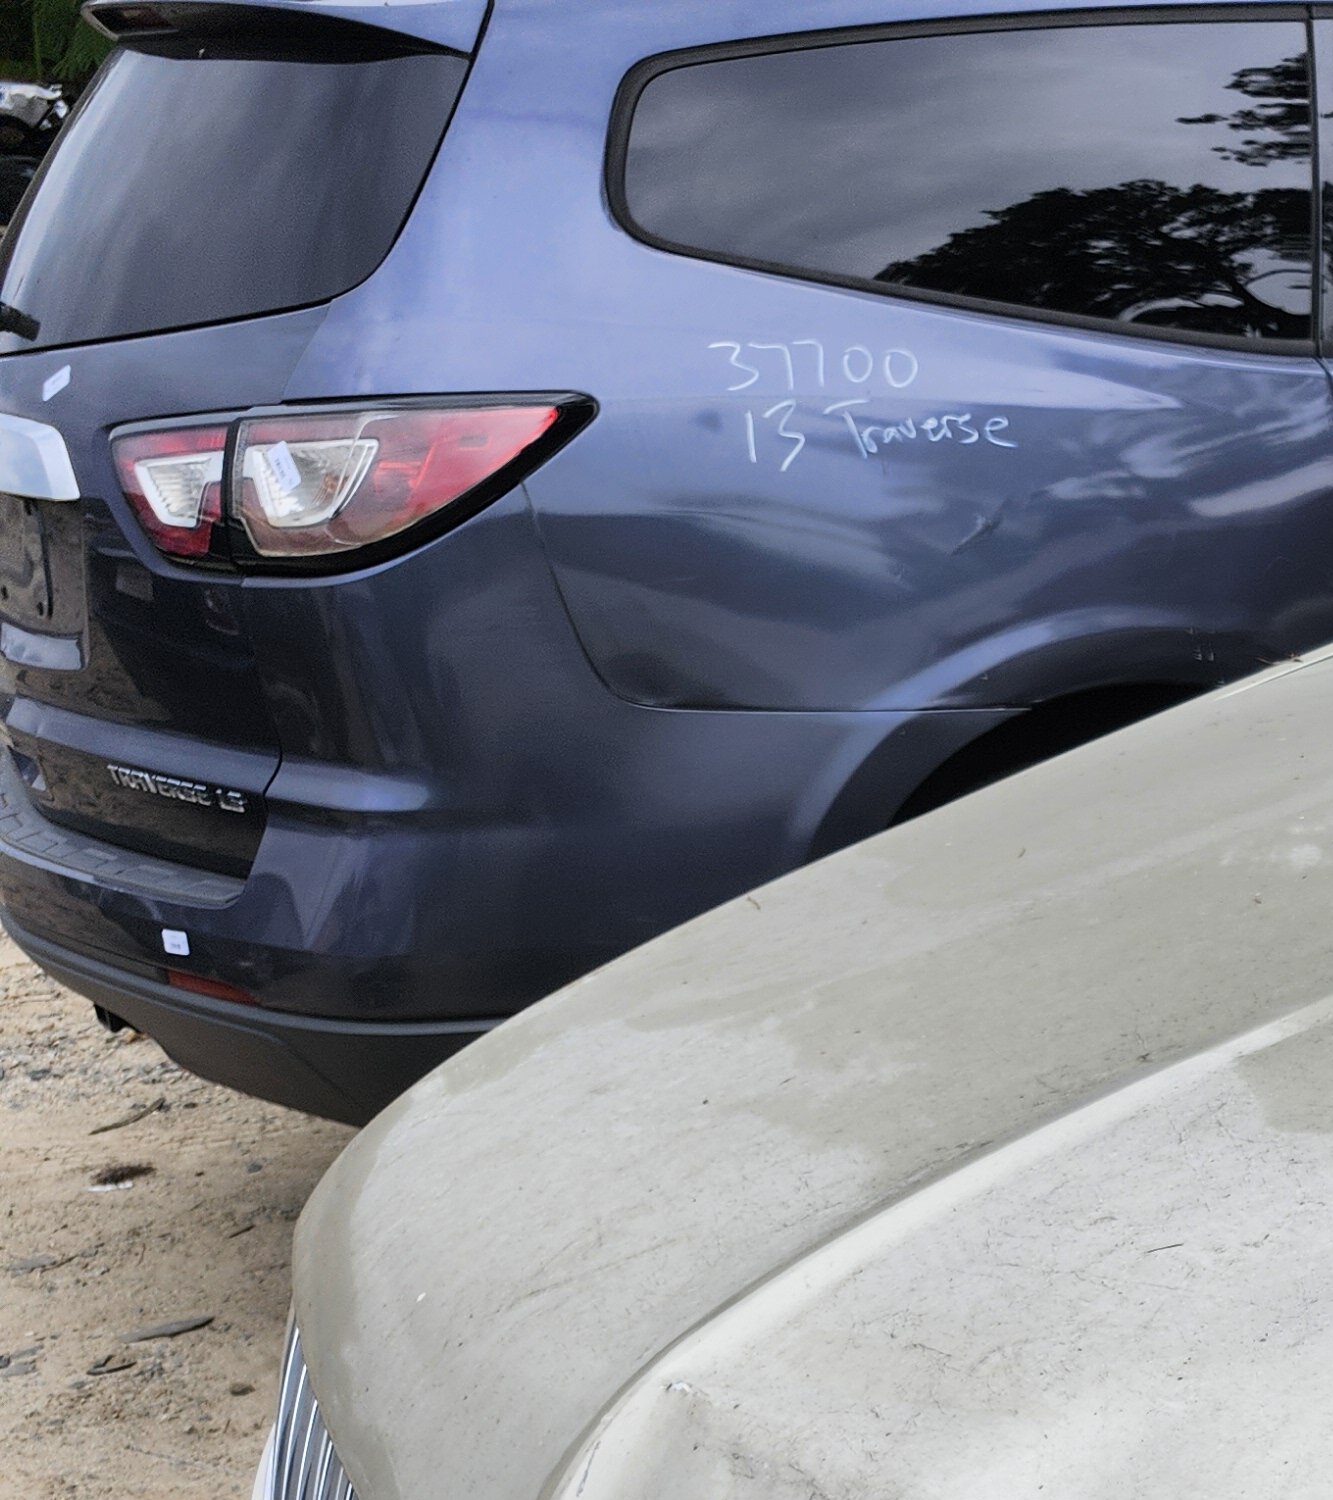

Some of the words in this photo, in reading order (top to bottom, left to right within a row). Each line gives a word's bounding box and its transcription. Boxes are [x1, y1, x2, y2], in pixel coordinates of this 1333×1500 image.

[707, 340, 919, 391] 37700
[744, 399, 806, 473] 13
[823, 398, 1019, 460] Traverse
[107, 763, 212, 807] TRAVERSE
